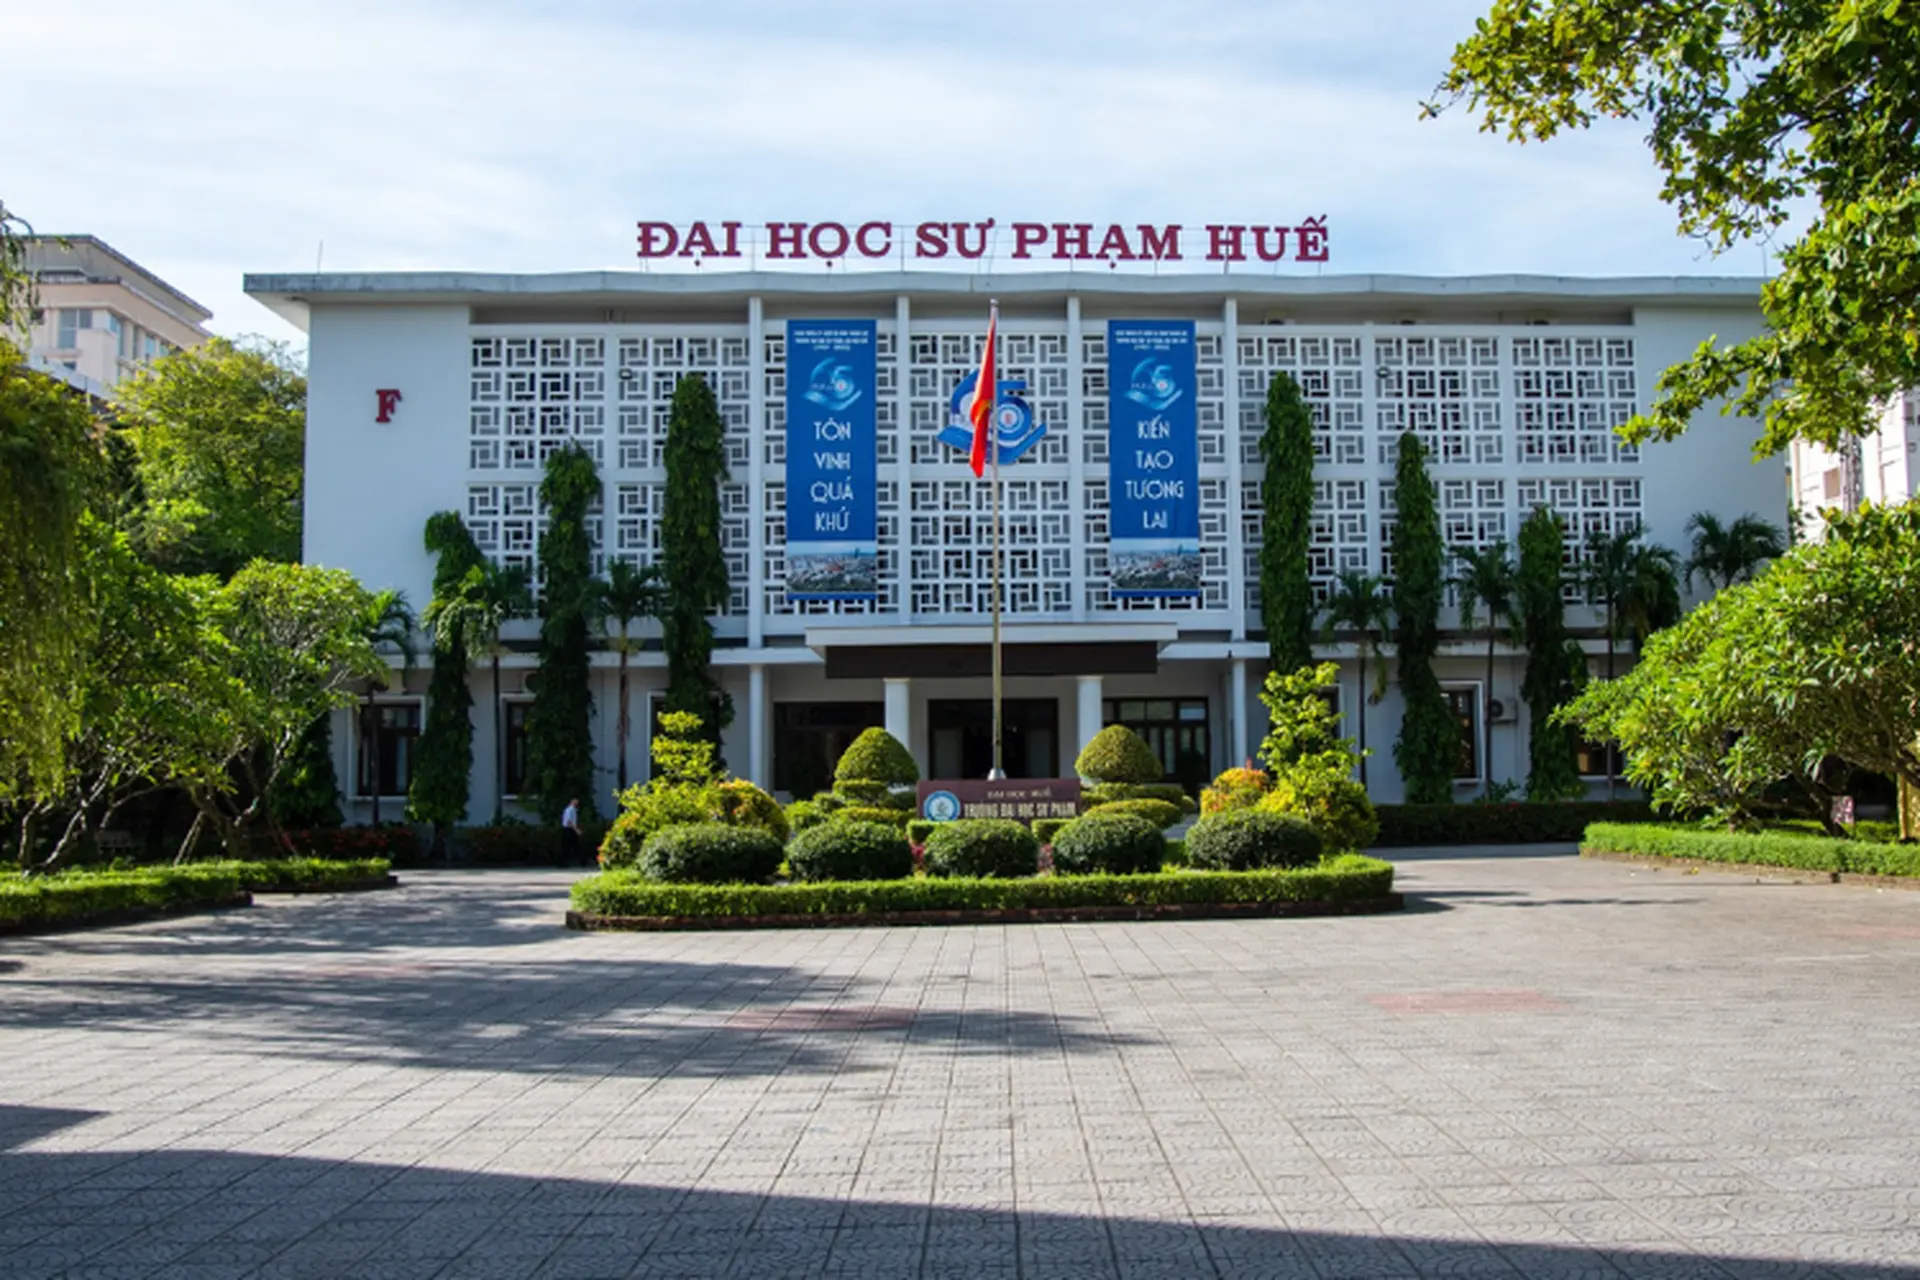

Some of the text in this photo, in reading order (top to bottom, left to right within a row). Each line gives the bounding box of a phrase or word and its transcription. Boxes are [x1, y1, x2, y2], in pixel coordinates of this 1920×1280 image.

[637, 214, 1329, 269] ĐẠI HỌC SƯ PHẠM HUẾ
[375, 388, 403, 424] F
[813, 416, 852, 440] TÔN
[1137, 413, 1170, 439] KIẾN
[813, 451, 851, 470] VINH
[1135, 449, 1174, 474] TẠO
[810, 475, 854, 503] QUÁ
[815, 505, 850, 532] KHỨ
[1143, 509, 1168, 529] LAI
